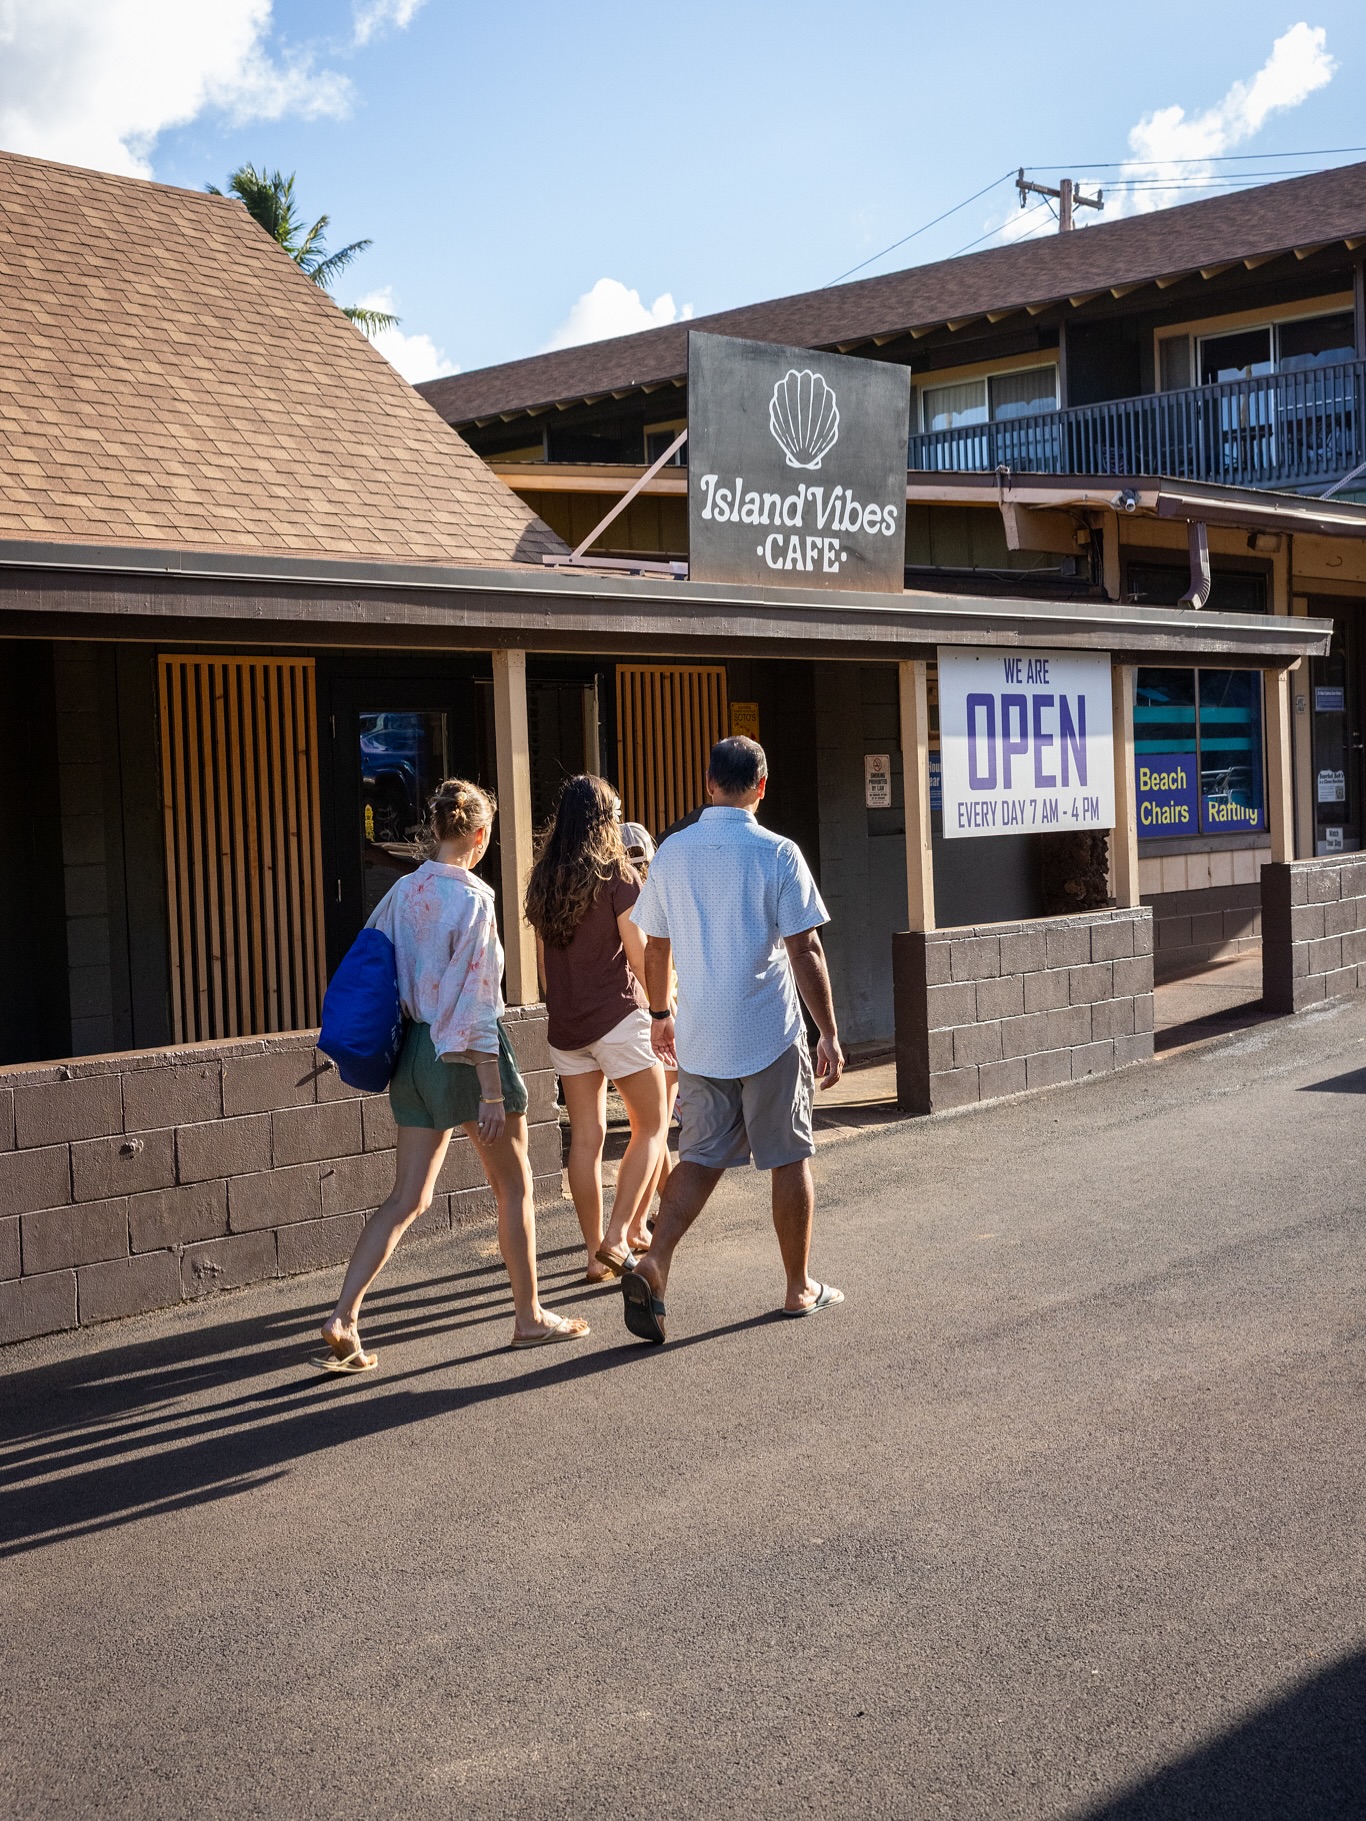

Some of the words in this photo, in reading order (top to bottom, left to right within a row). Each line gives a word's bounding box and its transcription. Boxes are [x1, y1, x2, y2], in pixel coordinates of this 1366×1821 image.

[700, 474, 806, 527] Island
[807, 485, 898, 536] Vibes
[765, 533, 840, 573] CAFE
[1004, 658, 1022, 684] WE
[1027, 659, 1049, 684] ARE
[966, 693, 1088, 790] OPEN
[1139, 766, 1187, 791] Beach
[957, 801, 997, 828] EVERY
[1002, 800, 1026, 826] DAY
[1029, 799, 1037, 824] 7
[1041, 798, 1059, 824] AM
[1071, 797, 1079, 822] 4
[1083, 796, 1100, 821] PM
[1140, 800, 1189, 826] Chairs
